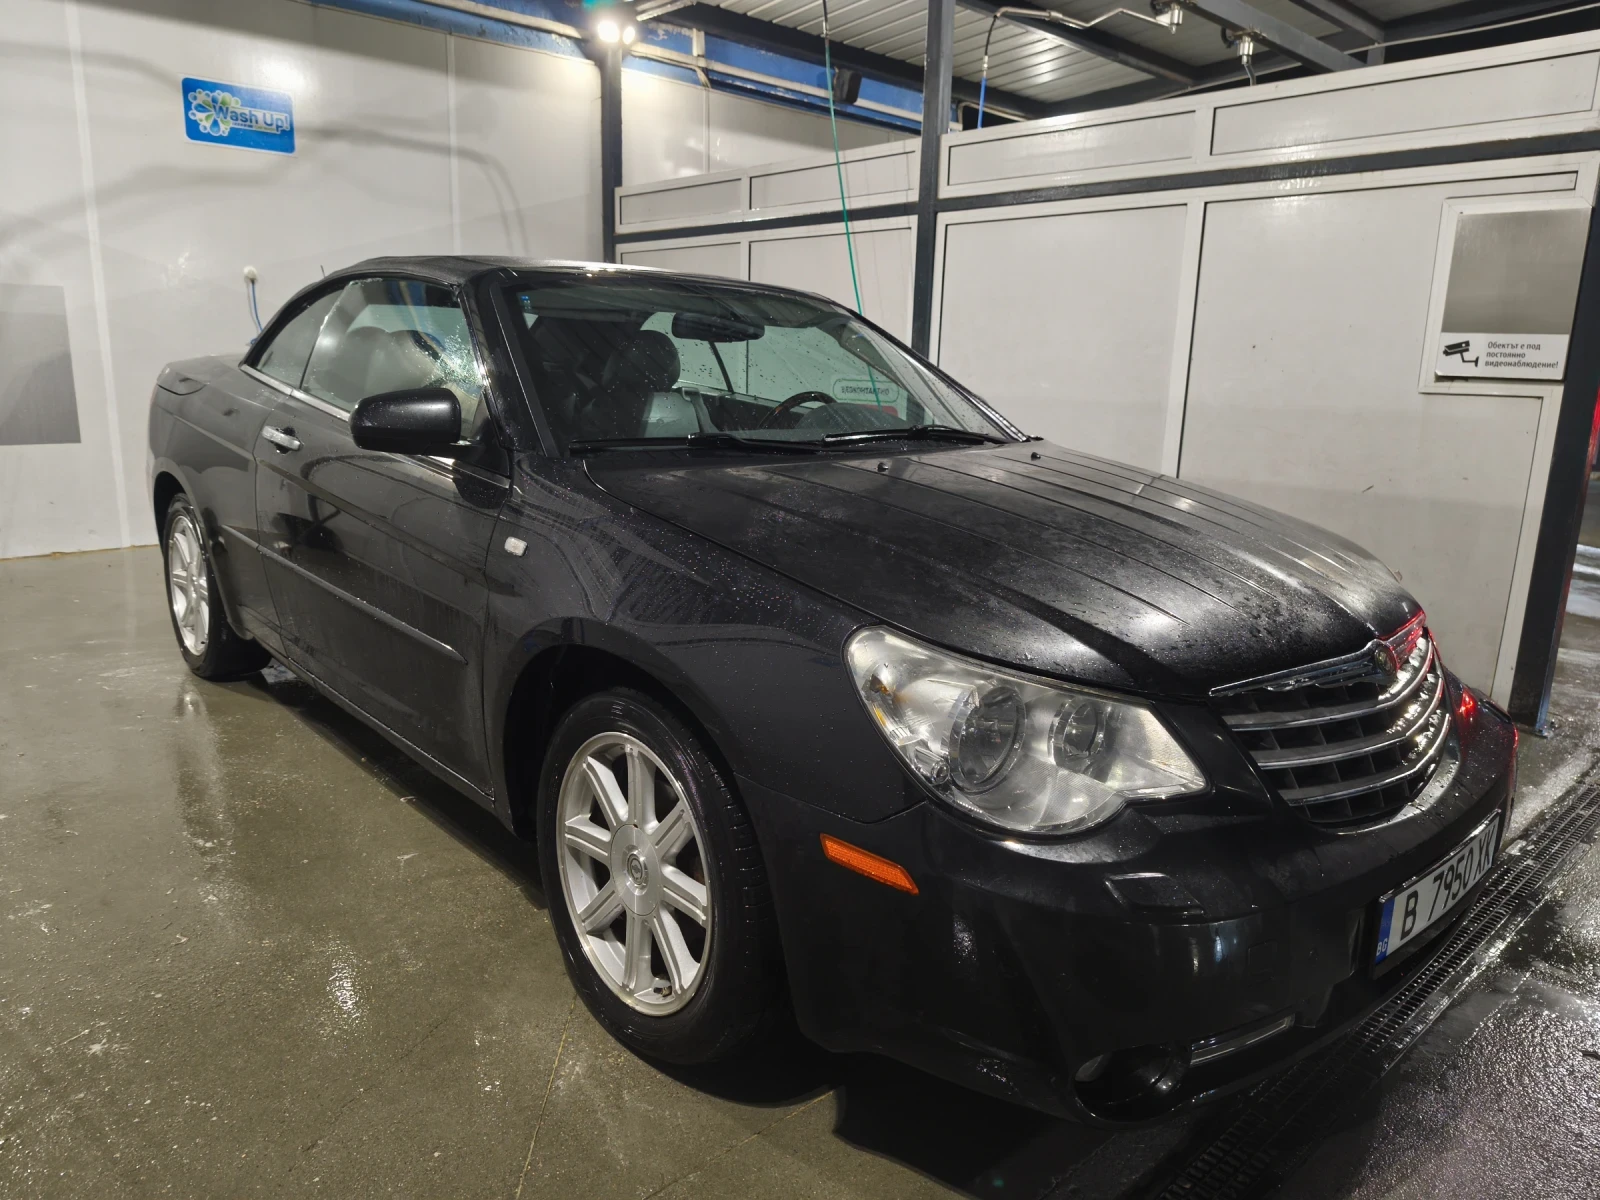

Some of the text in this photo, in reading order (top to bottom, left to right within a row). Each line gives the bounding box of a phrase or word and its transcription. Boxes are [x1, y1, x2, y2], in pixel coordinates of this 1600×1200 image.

[213, 105, 258, 124] Wash
[263, 112, 289, 132] Up!
[1488, 341, 1519, 350] Обектът
[1526, 343, 1541, 351] под
[1400, 890, 1419, 941] B
[1427, 847, 1474, 922] 7950
[1376, 938, 1389, 957] BG
